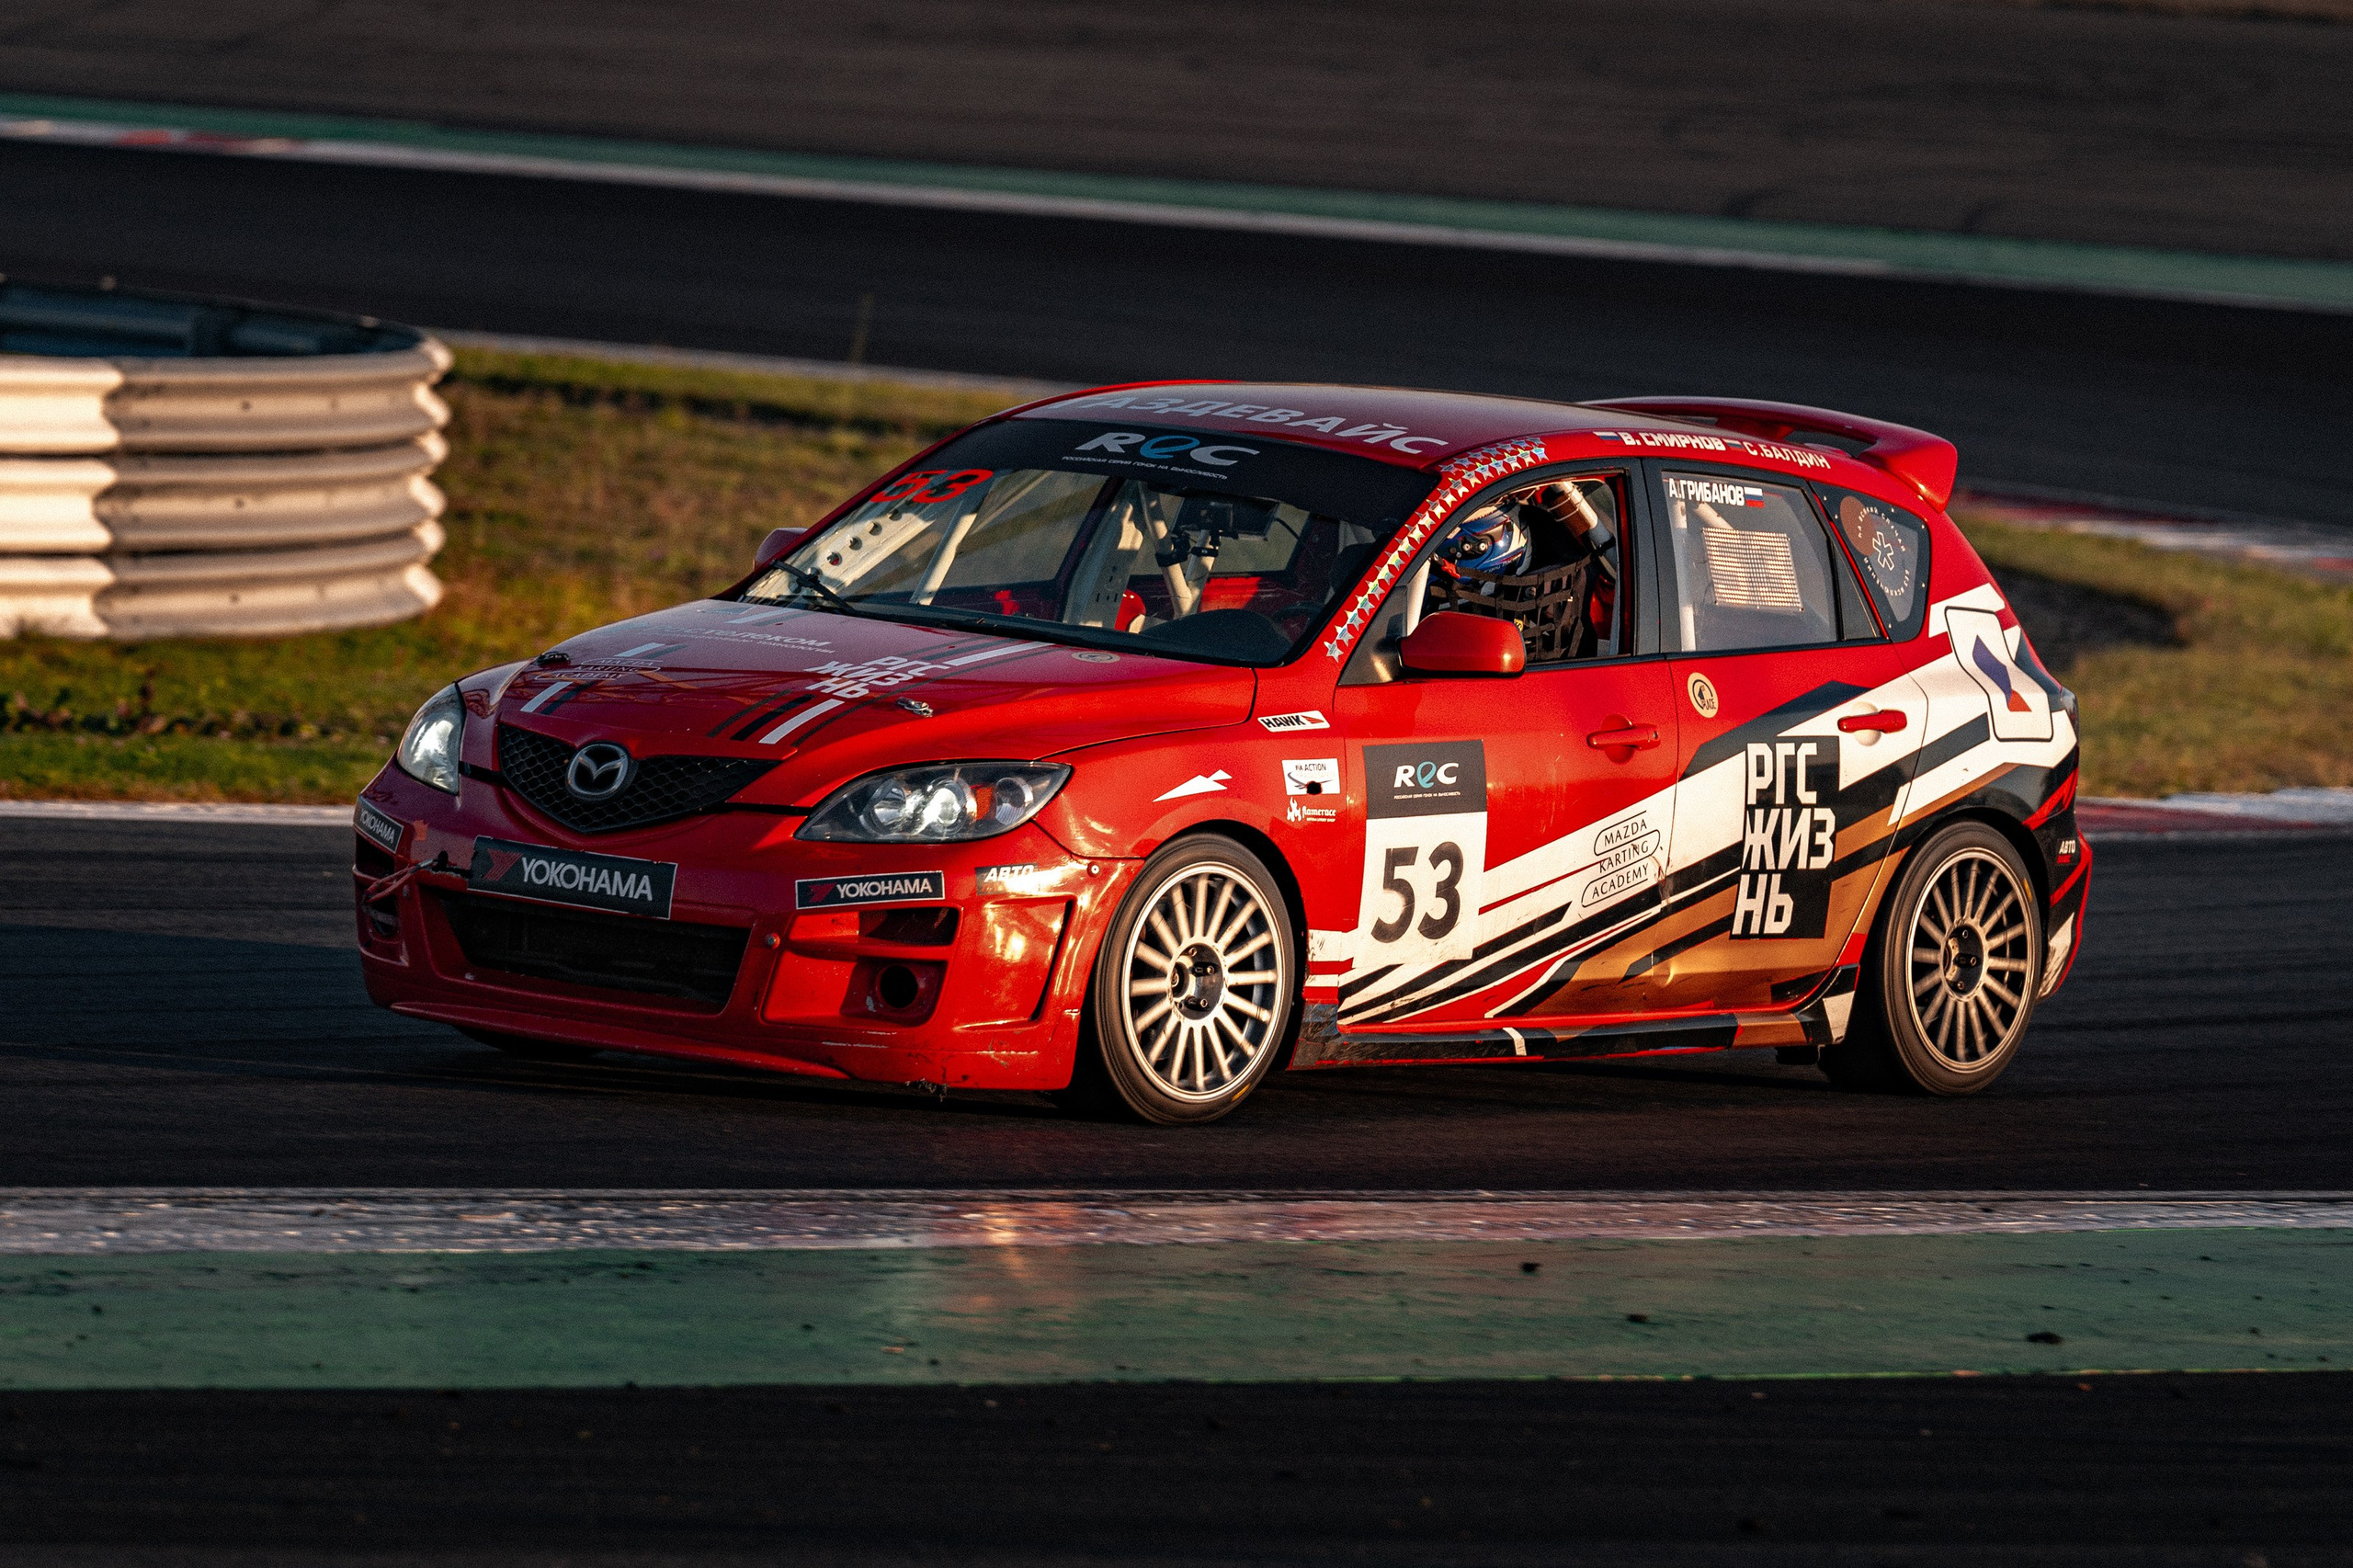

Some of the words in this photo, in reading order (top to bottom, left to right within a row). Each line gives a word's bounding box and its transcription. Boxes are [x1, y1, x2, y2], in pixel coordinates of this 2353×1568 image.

[1047, 396, 1449, 454] ГАЗДЕВАЙС
[1644, 432, 1726, 451] СМИРНОВ
[870, 469, 994, 503] 53
[803, 661, 914, 686] ЖИЗ
[861, 655, 950, 676] РГС
[805, 676, 870, 699] НЬ
[1260, 715, 1306, 729] HAWK
[1304, 763, 1326, 771] ACTION
[1746, 743, 1818, 805] РГС
[1604, 818, 1648, 846] MAZDA
[1741, 807, 1836, 870] ЖИЗ
[1599, 840, 1649, 873] KARTING
[521, 857, 654, 902] YOKOHAMA
[836, 878, 934, 899] YOKOHAMA
[1370, 841, 1464, 943] 53
[1592, 862, 1649, 899] ACADEMY
[1732, 873, 1794, 935] НЬ
